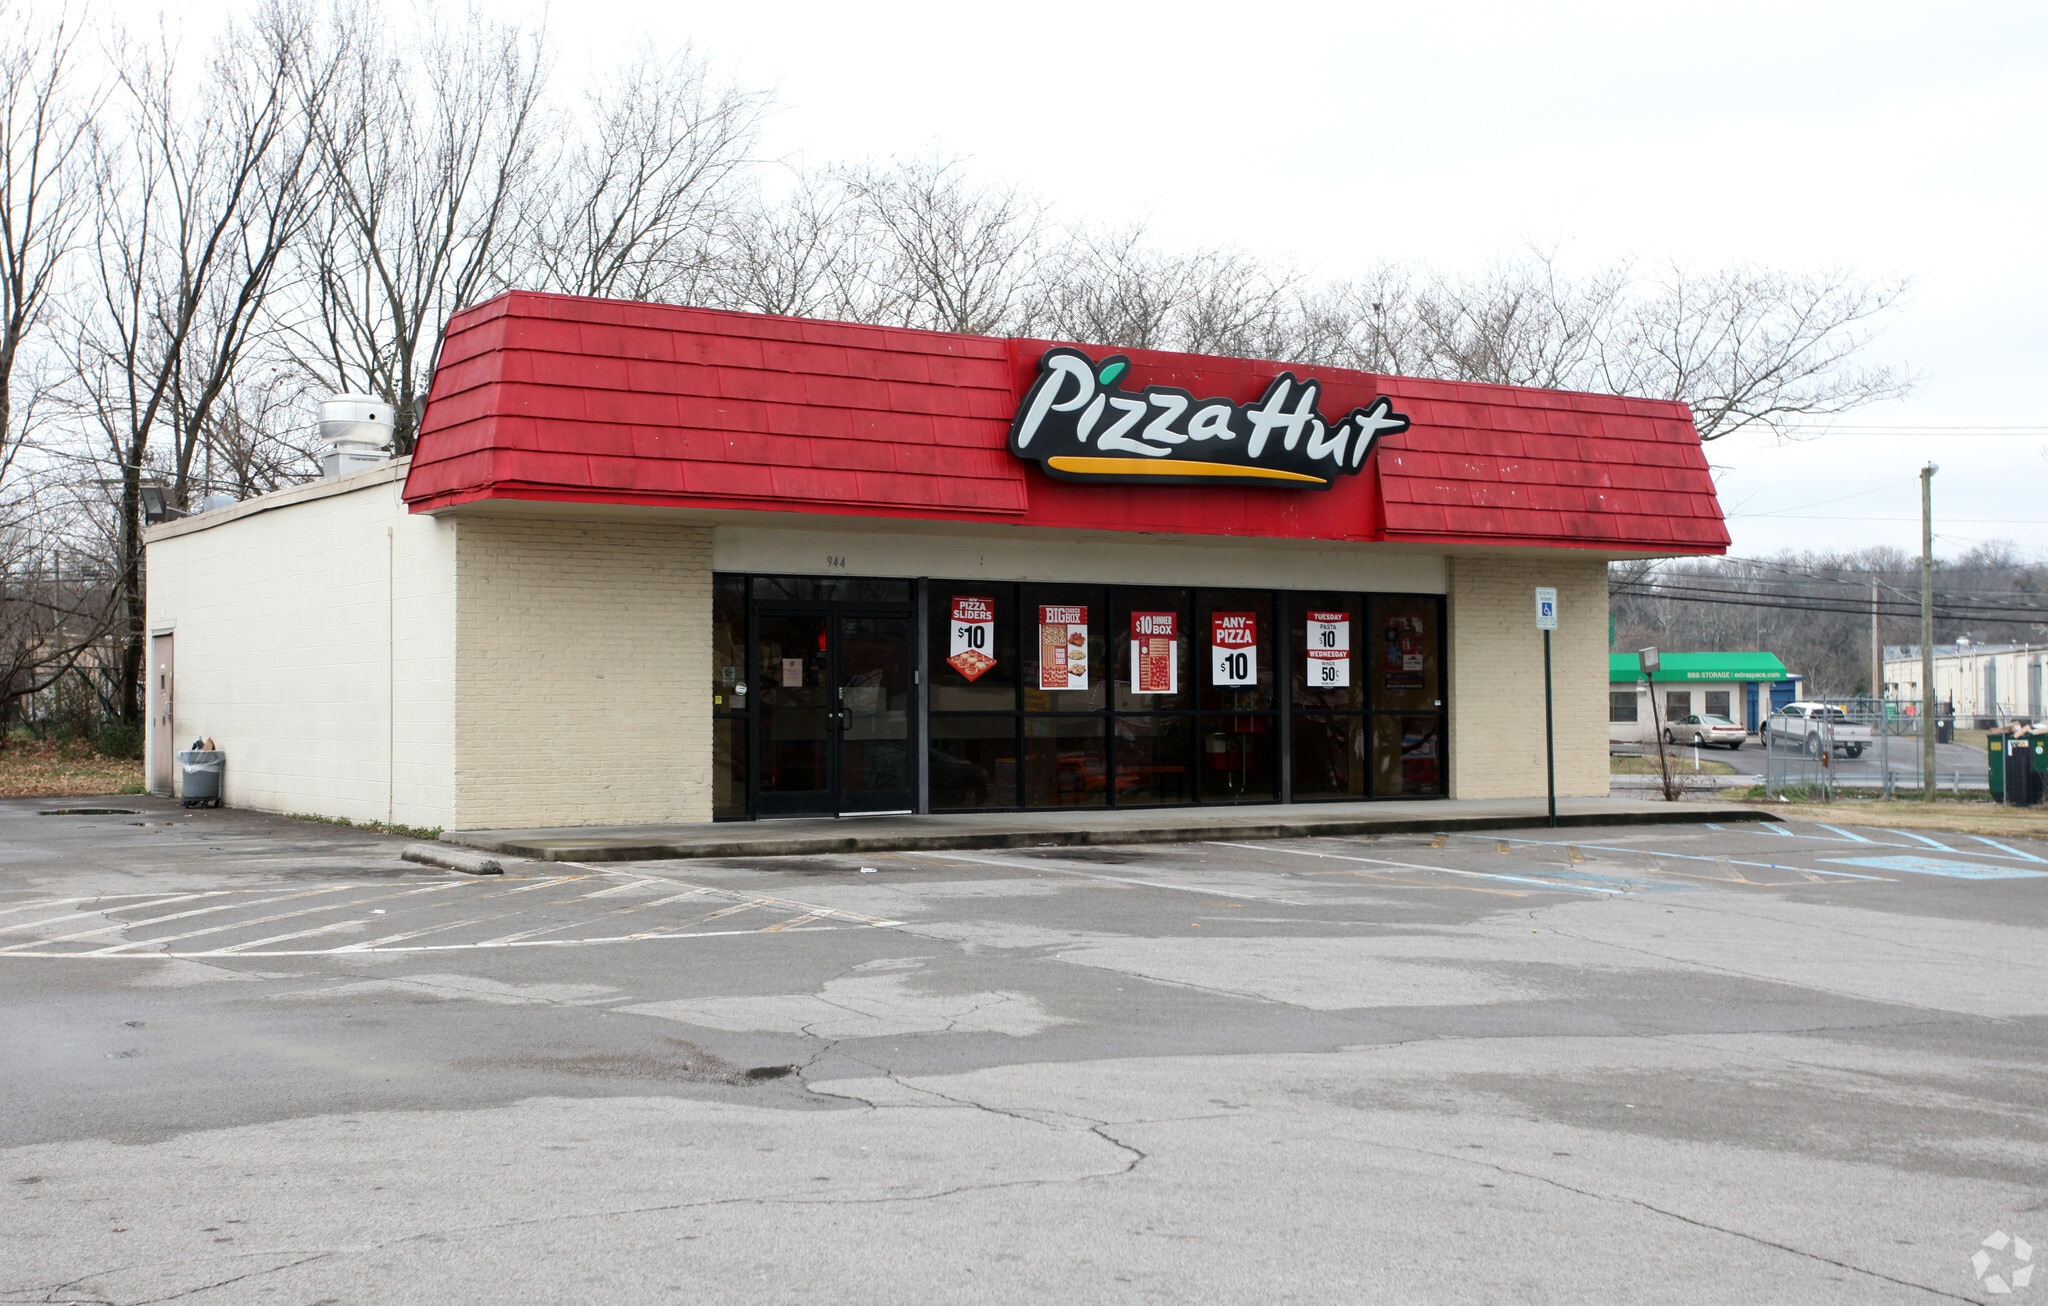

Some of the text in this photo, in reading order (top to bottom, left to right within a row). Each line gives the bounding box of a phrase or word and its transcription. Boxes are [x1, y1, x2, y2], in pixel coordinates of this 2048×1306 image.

[1018, 354, 1405, 468] Pizza Hut
[826, 555, 846, 568] 944
[959, 601, 986, 610] PIZZA
[953, 609, 992, 619] SLIDERS
[1045, 607, 1066, 623] BIG
[1065, 613, 1081, 623] BOX
[1135, 615, 1172, 635] $10 DINNER
[1152, 625, 1172, 635] BOX
[958, 625, 985, 649] $10
[1216, 629, 1253, 644] PIZZA
[1319, 630, 1335, 648] $10
[1309, 650, 1347, 658] WEDNESDAY
[1220, 652, 1248, 680] $10
